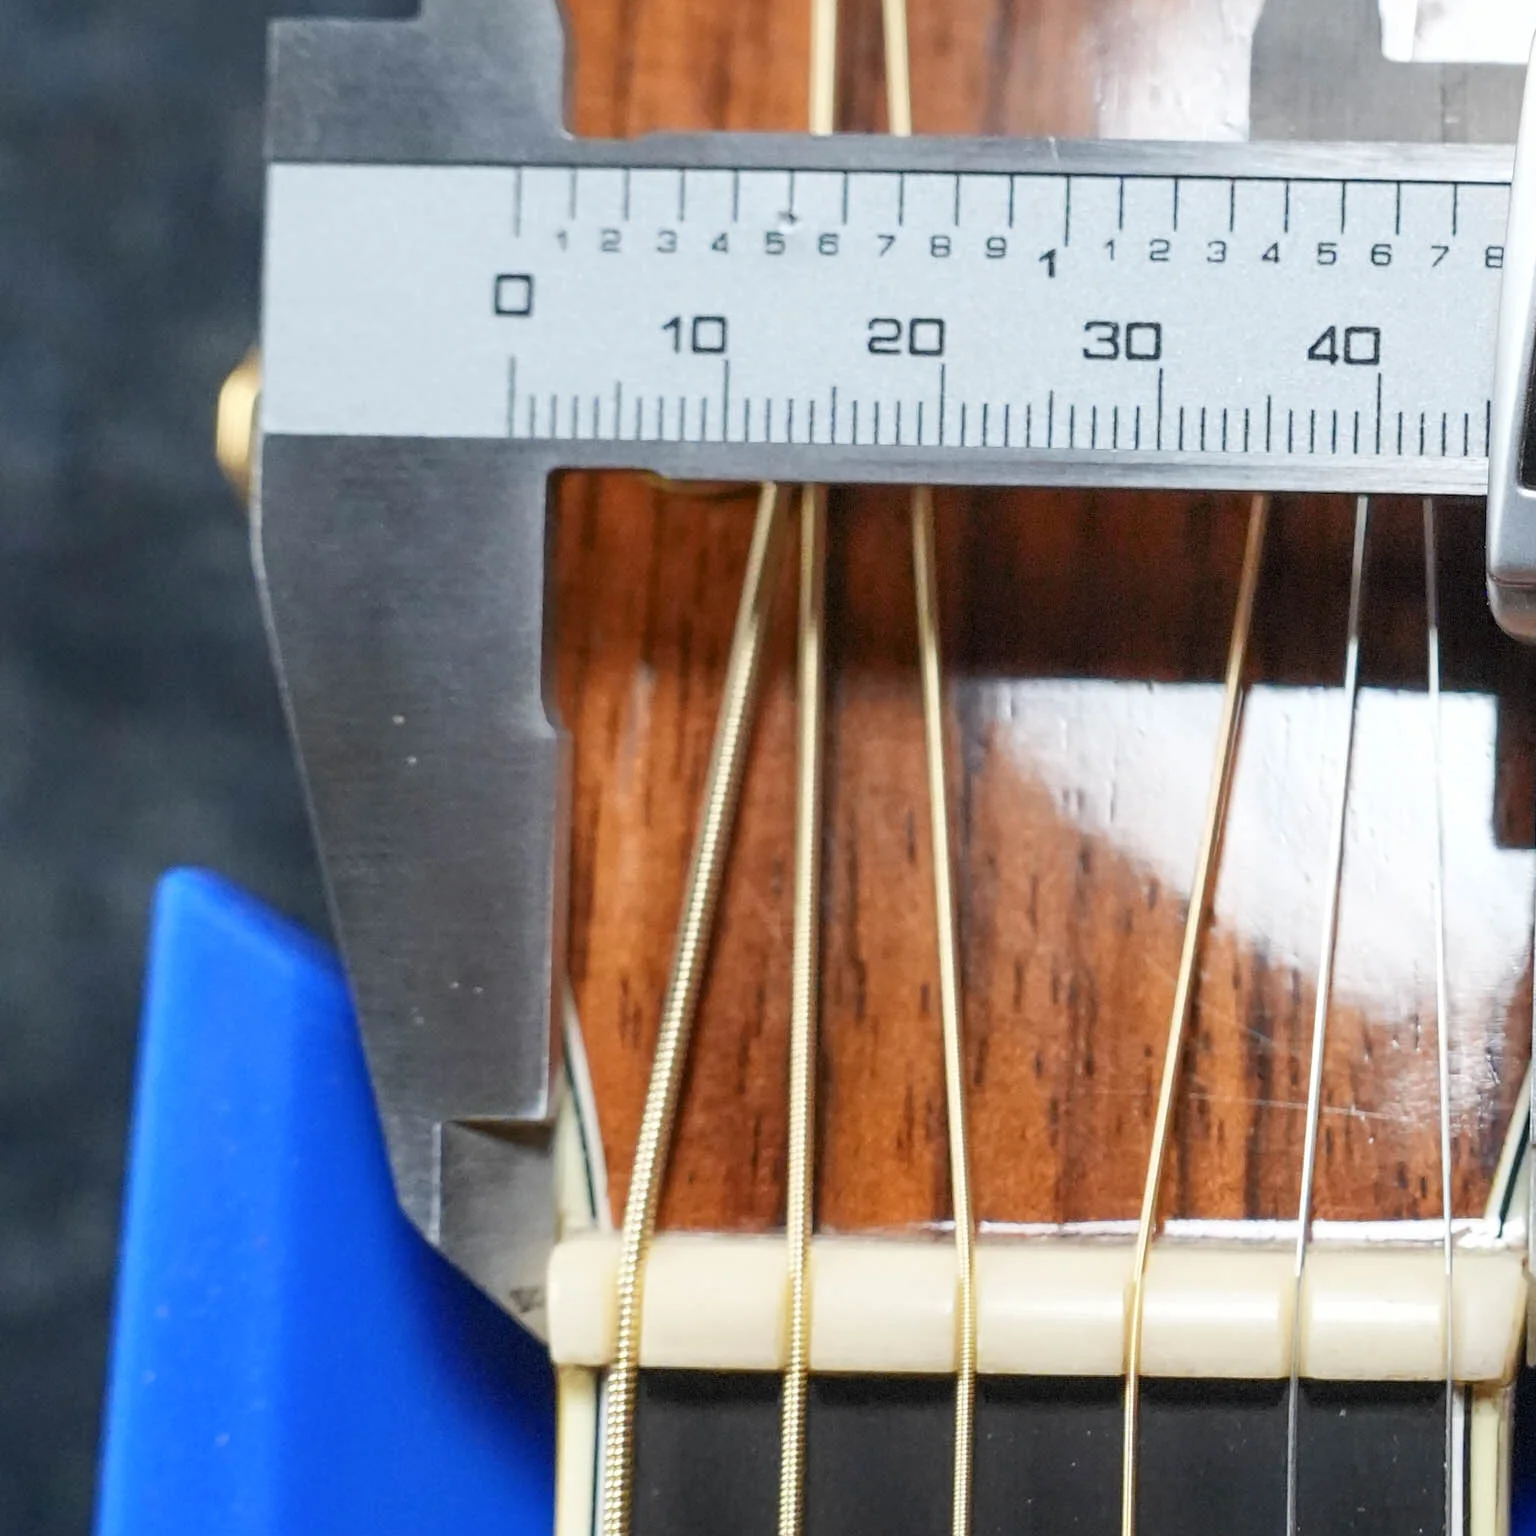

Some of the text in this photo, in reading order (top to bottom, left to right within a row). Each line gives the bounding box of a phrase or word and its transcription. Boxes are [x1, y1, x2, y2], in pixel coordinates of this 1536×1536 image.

[493, 228, 1505, 317] 0 1 2 3 4 5 6 7 8 9 1 1 2 3 4 5 6 7 8
[661, 315, 1381, 366] 10 20 30 40
